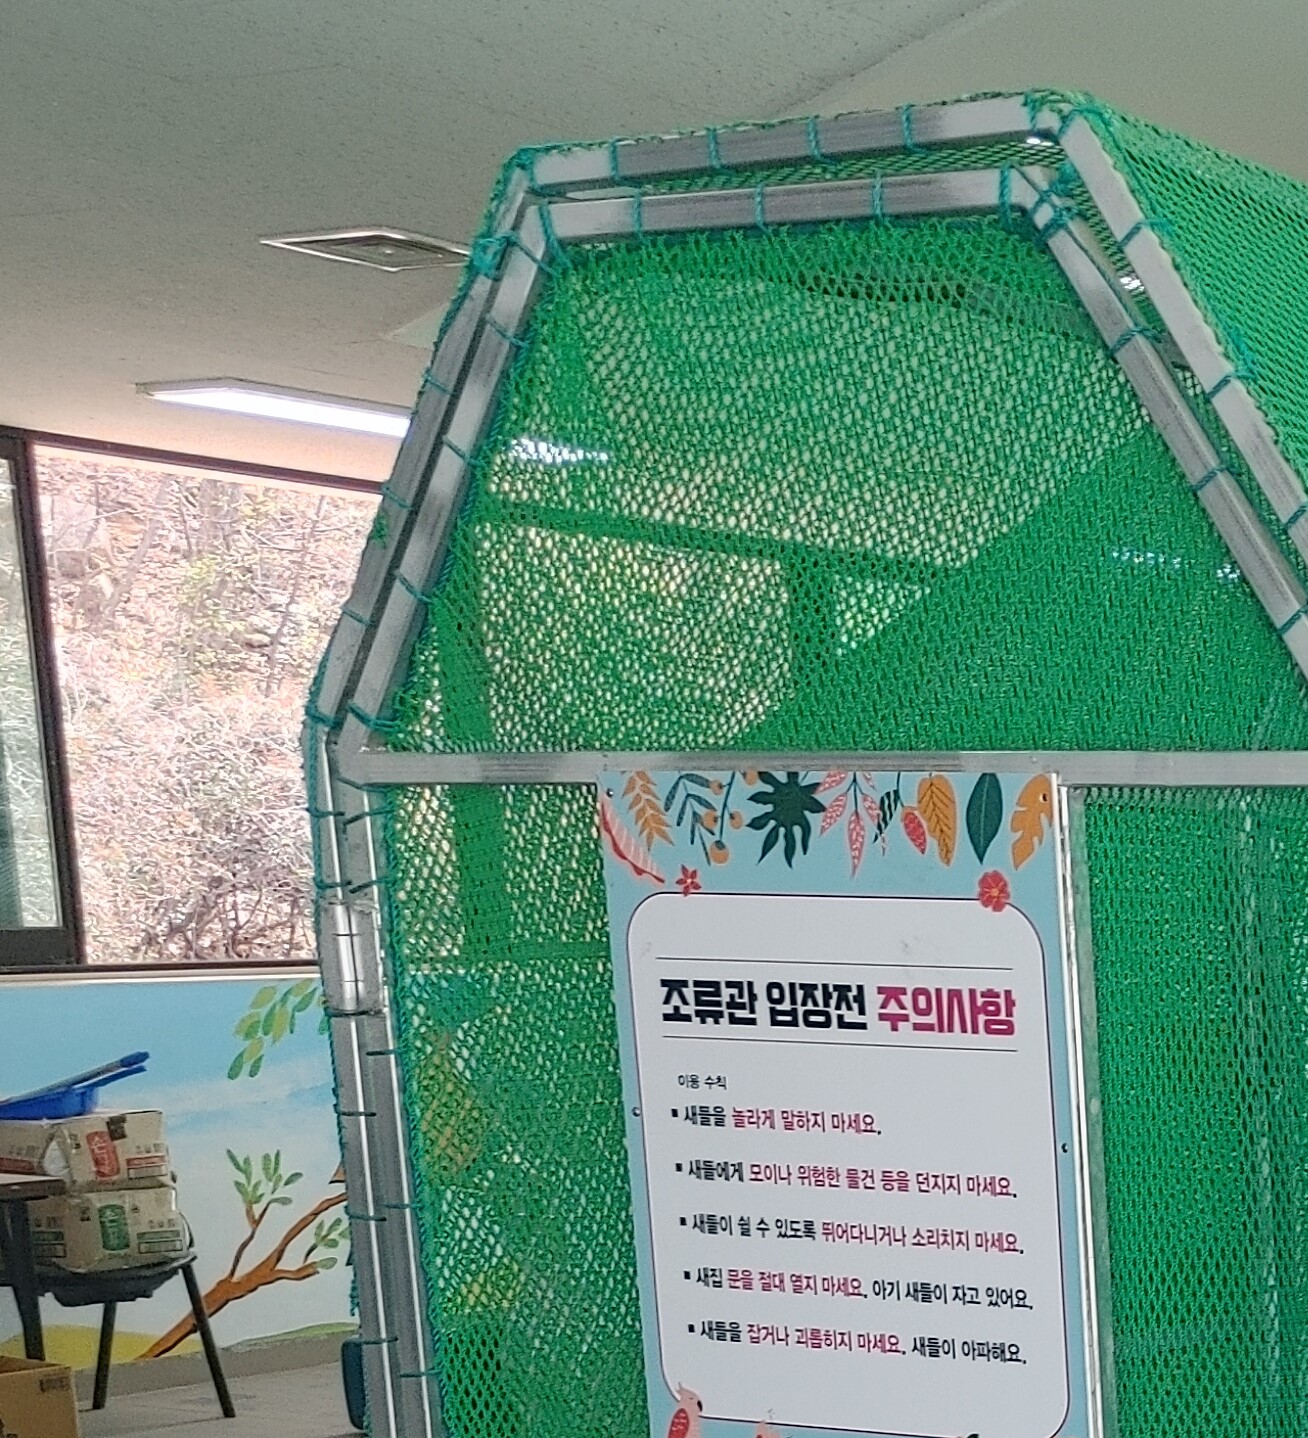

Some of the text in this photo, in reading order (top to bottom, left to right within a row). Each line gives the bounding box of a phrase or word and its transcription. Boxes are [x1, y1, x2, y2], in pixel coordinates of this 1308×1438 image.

[660, 978, 1016, 1036] 조류관 입장전 주의사항
[678, 1074, 727, 1090] 이용 수칙
[683, 1105, 881, 1135] 새들을 놀라게 말하지 마세요.
[689, 1159, 1017, 1198] 새들에게 모이나 위험한 물건 등을 던지지 마세요.
[692, 1213, 1024, 1254] 새들이 쉴 수 있도록 뛰어다니거나 소리치지 마세요.
[696, 1267, 1033, 1310] 새집 문을 절대 열지 마세요. 아기 새들이 자고 있어요.
[700, 1320, 1026, 1364] 새들을 잡거나 괴롭히지 마세요. 새들이 아파해요.
